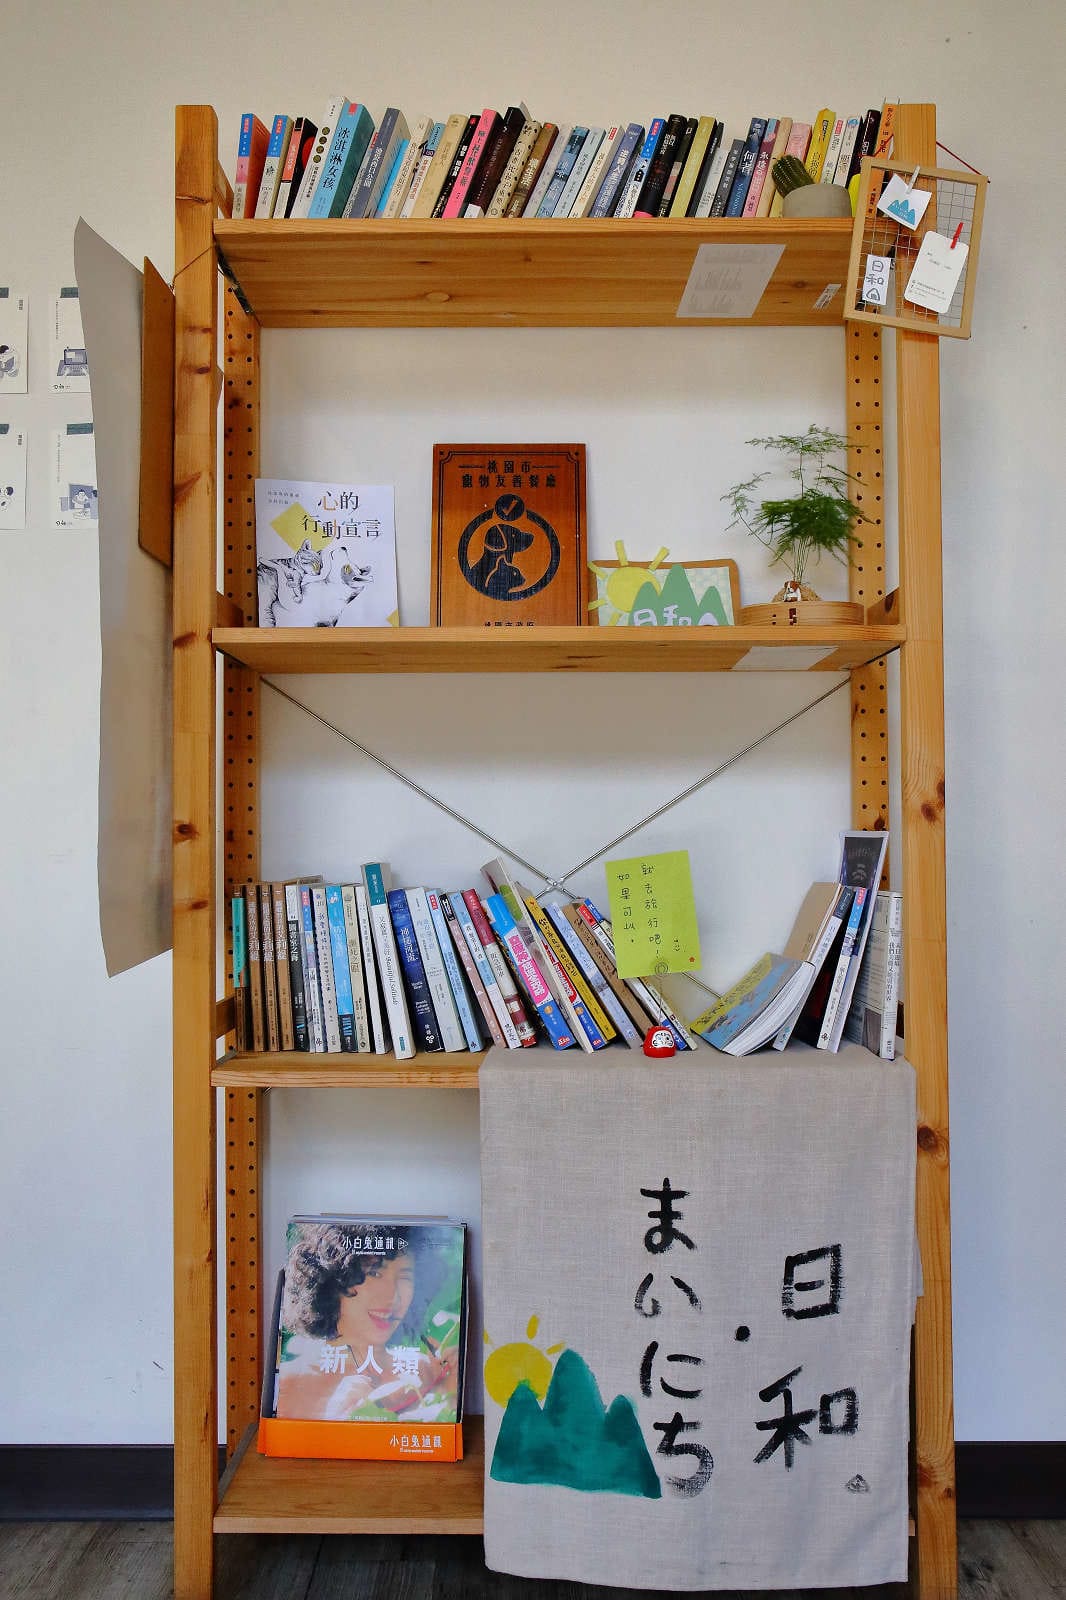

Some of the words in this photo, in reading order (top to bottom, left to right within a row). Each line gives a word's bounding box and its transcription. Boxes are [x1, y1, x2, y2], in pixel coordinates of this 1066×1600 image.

[322, 127, 350, 190] 冰淇淋女孩
[742, 150, 755, 175] 何者
[487, 460, 532, 474] 桃園市
[318, 490, 359, 512] 心的
[301, 514, 381, 540] 行動宣言
[343, 1236, 395, 1250] 小白兔通訊
[634, 1176, 715, 1498] まいにち
[319, 1344, 421, 1376] 新人類
[753, 1244, 860, 1472] 日和
